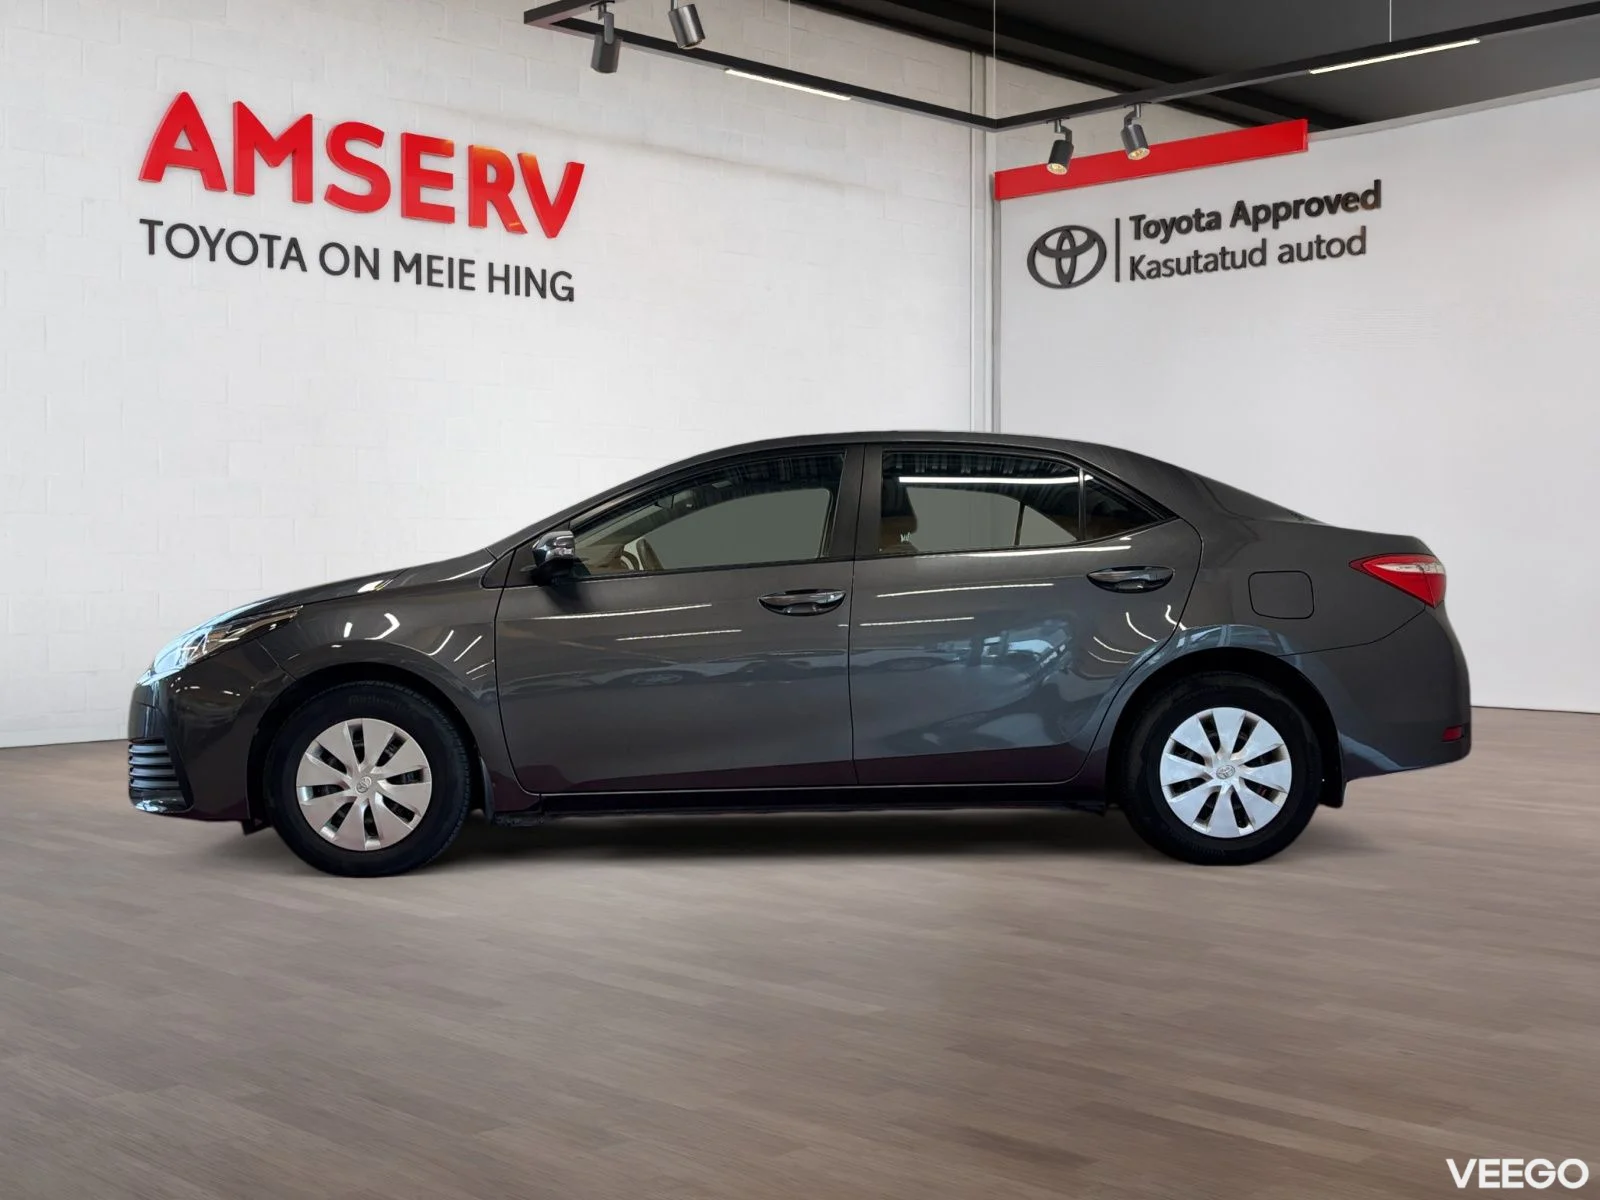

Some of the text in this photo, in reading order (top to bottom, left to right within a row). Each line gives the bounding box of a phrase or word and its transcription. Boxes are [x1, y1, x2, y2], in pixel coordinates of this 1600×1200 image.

[139, 91, 585, 239] AMSERV
[1129, 178, 1382, 245] Toyota Approved
[139, 218, 575, 303] TOYOTA ON MEIE HING
[1129, 225, 1367, 282] Kasutatud autod
